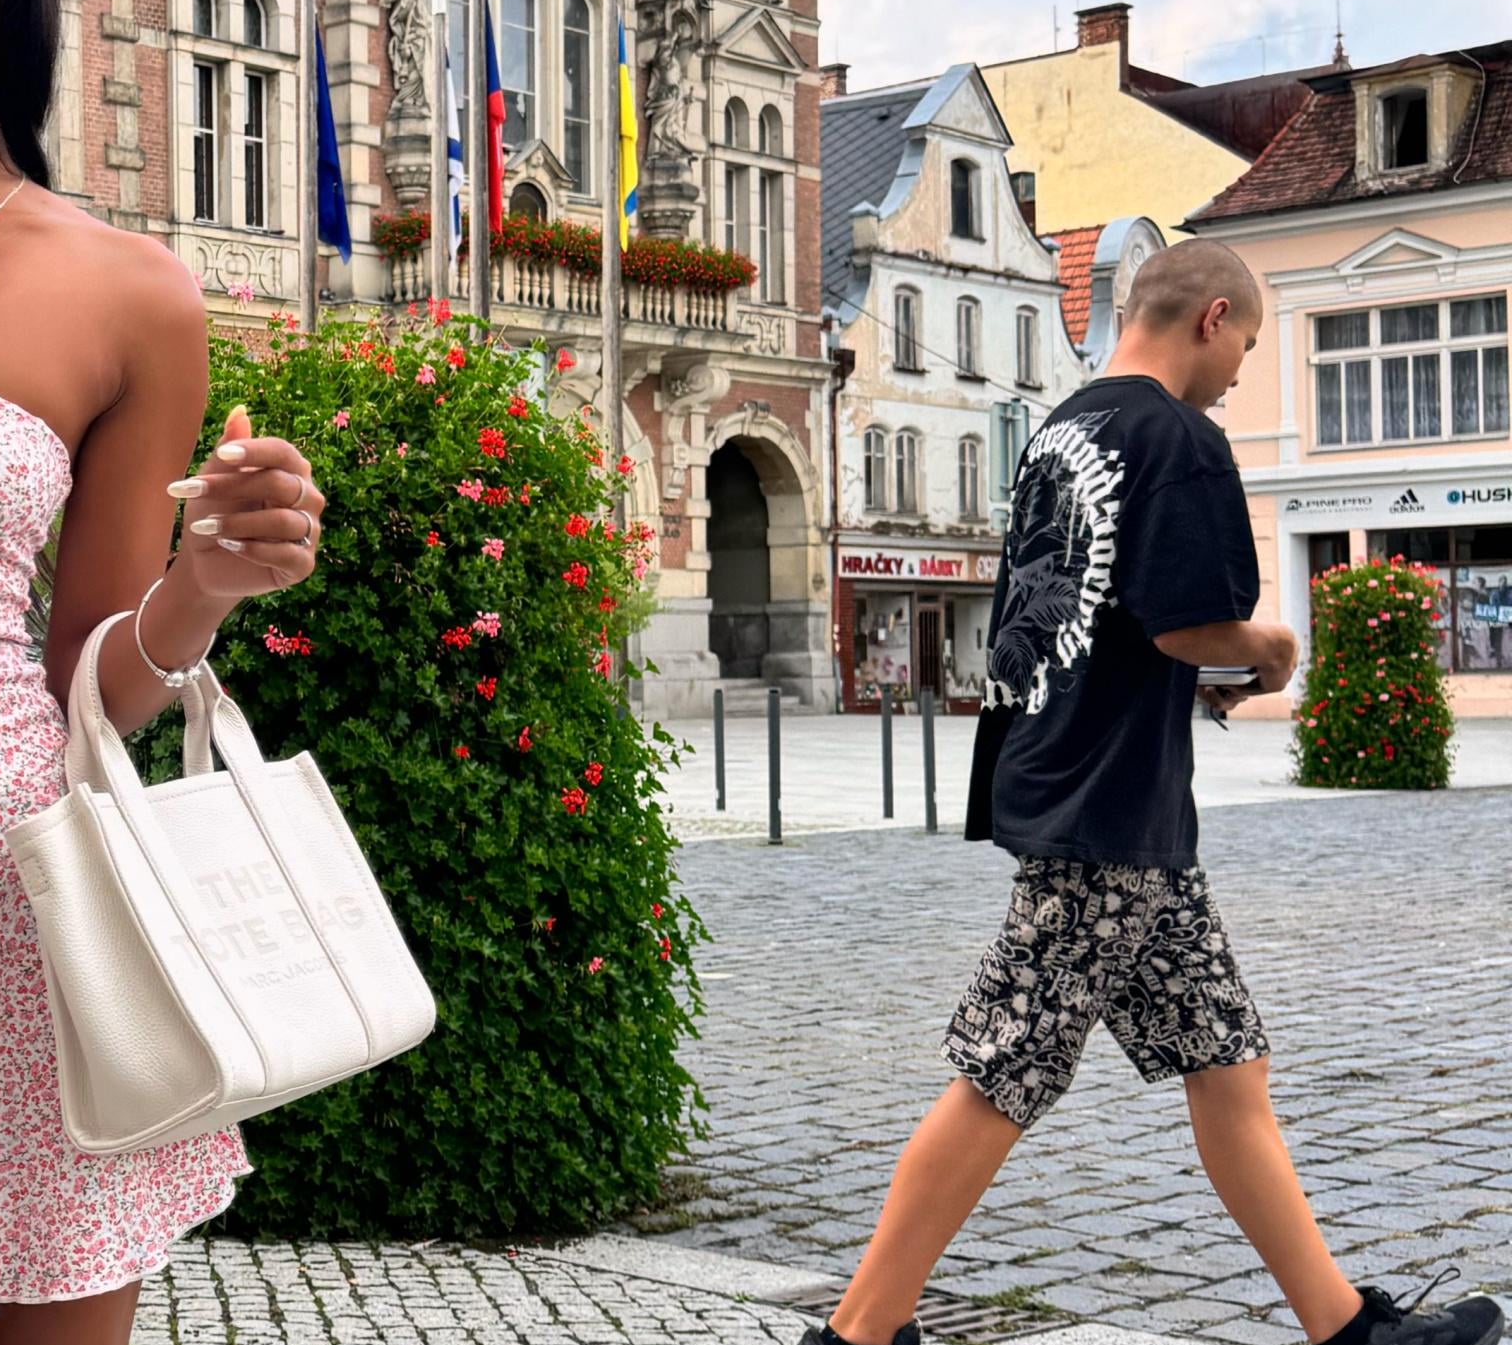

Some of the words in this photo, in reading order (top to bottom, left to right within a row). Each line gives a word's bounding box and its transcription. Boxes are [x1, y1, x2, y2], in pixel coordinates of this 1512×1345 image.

[1389, 504, 1425, 514] adidas
[842, 552, 904, 575] HRAČKY
[919, 554, 963, 577] DÁRKY
[193, 860, 286, 909] THE
[170, 916, 280, 970] TOTE
[278, 895, 367, 945] BAG
